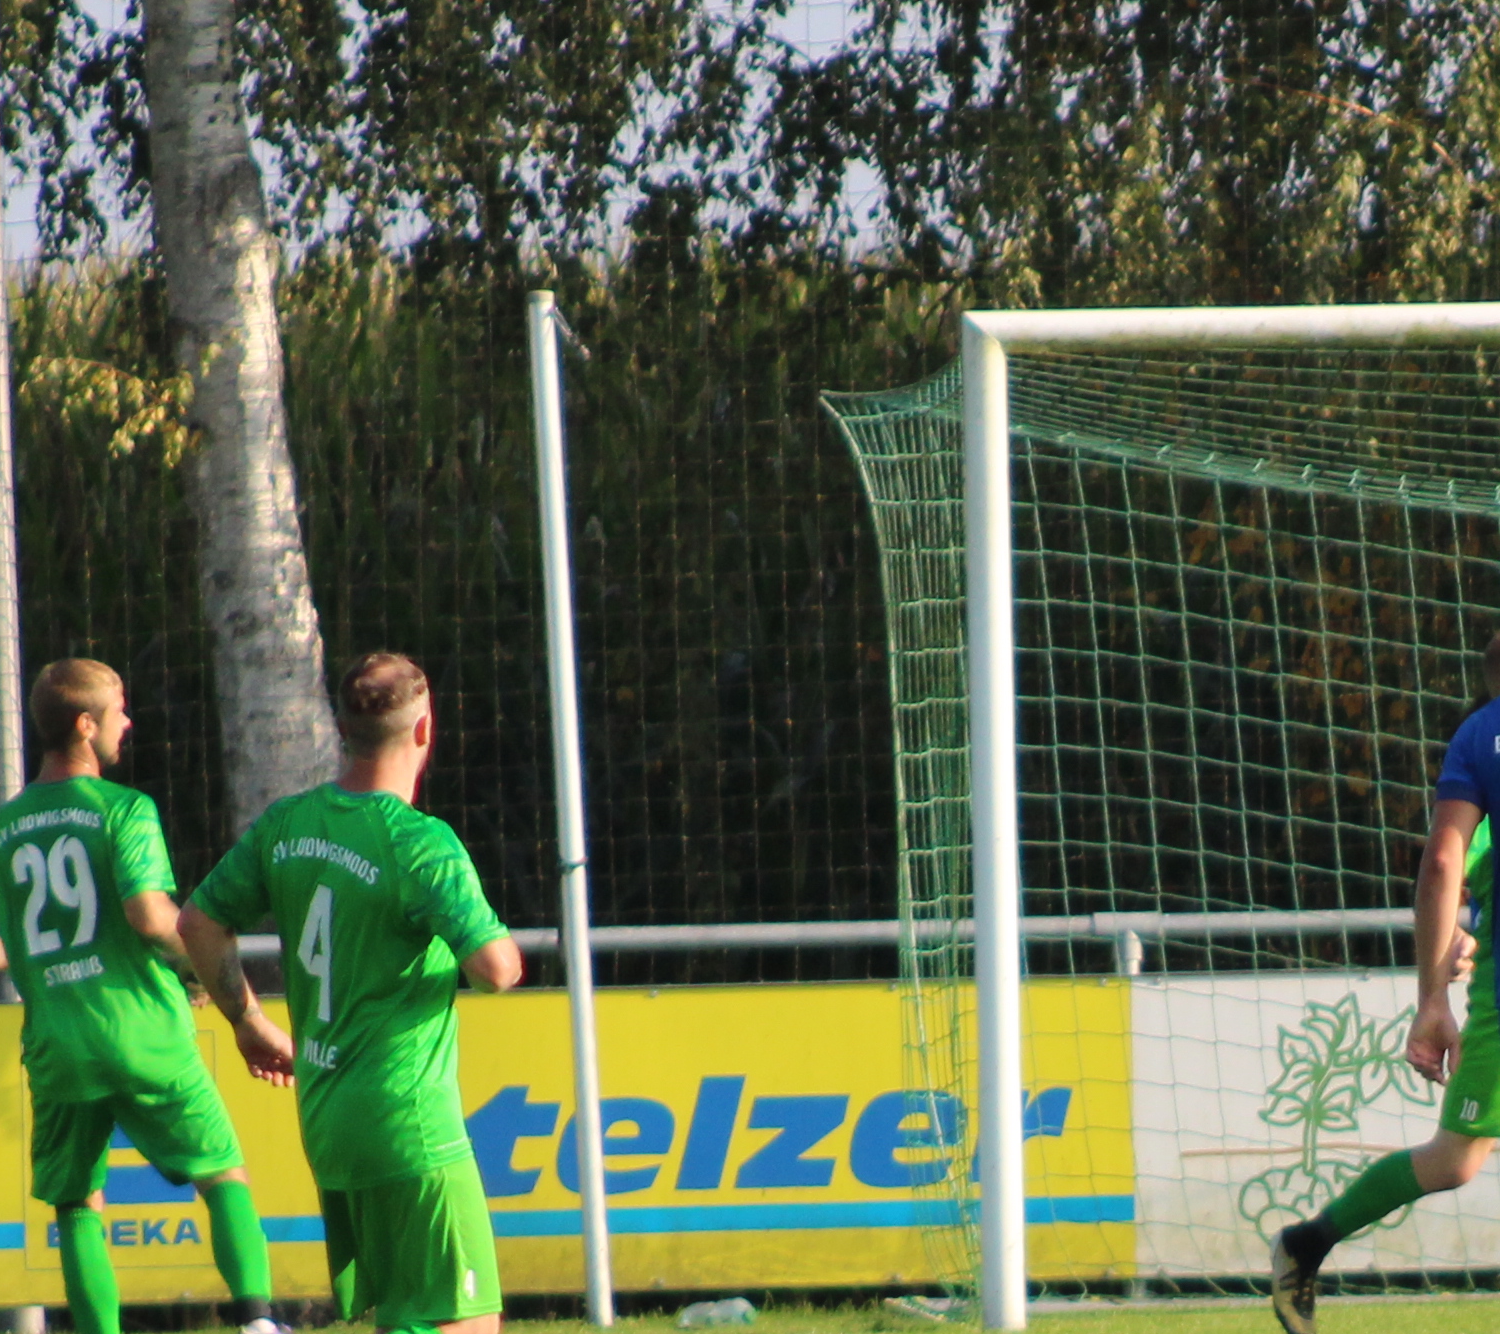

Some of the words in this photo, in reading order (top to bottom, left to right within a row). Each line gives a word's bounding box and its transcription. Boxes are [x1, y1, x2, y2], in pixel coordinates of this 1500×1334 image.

[10, 807, 101, 835] LUDWIGSMOOS
[272, 839, 288, 864] SV
[290, 836, 379, 885] LUDWGSMOOS
[12, 834, 97, 956] 29
[297, 884, 332, 1022] 4
[1459, 1097, 1479, 1122] 10
[47, 1218, 202, 1248] EEKA
